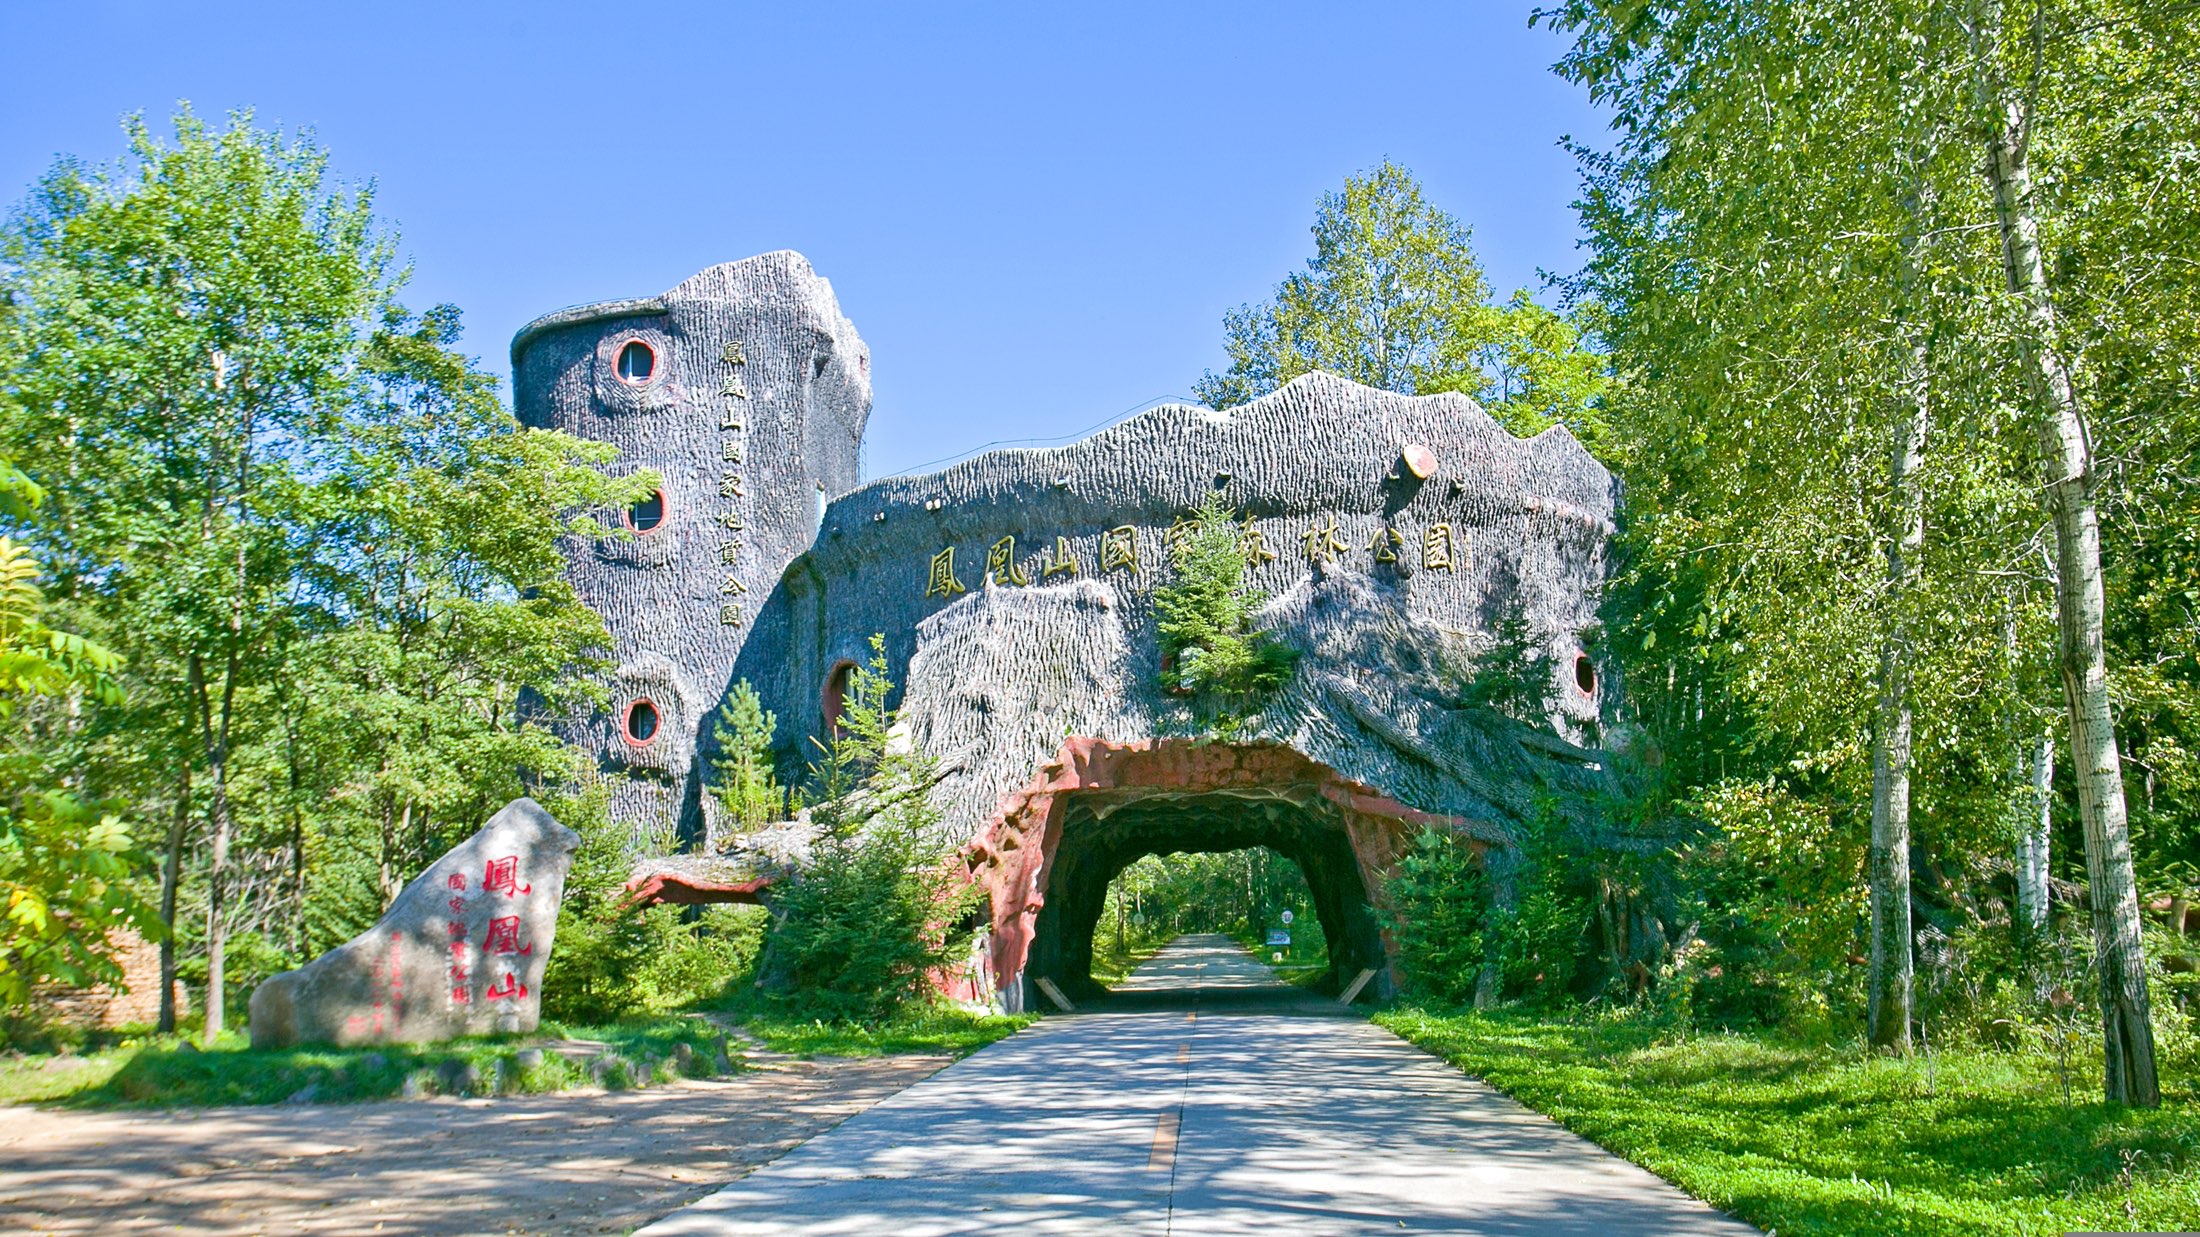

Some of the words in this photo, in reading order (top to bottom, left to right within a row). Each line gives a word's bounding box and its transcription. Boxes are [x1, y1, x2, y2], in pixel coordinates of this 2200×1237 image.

[717, 340, 747, 628] 鳳凰山國家地質公園
[482, 854, 532, 1002] 鳳凰山
